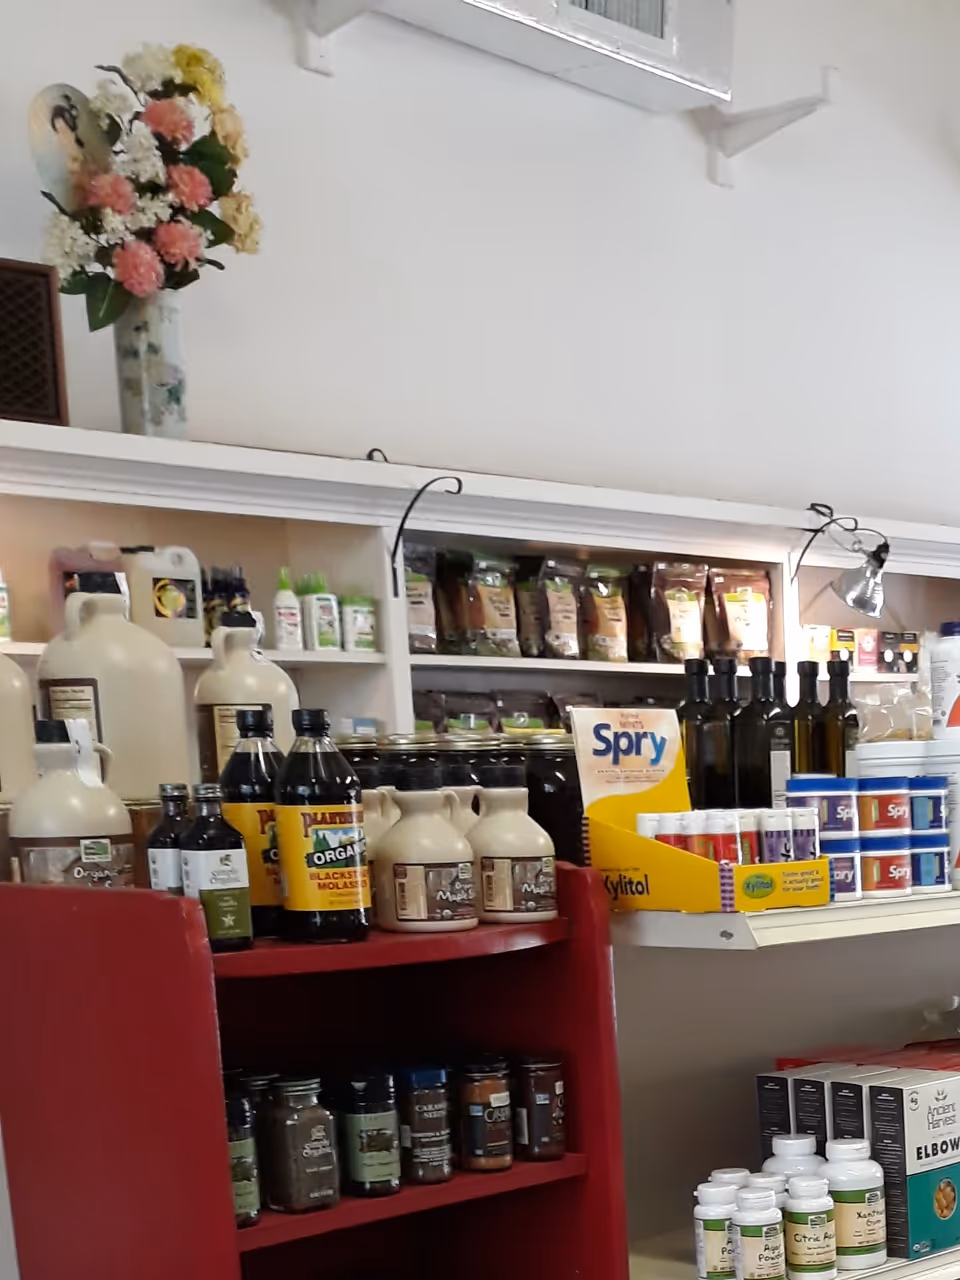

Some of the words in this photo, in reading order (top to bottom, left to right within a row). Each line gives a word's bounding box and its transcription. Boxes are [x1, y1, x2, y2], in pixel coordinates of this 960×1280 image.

[593, 723, 667, 766] Spry
[313, 840, 366, 865] ORGAN
[927, 1103, 956, 1116] Ancient
[927, 1114, 956, 1130] Harvest
[794, 1233, 821, 1243] Citric
[824, 1232, 834, 1240] Aci
